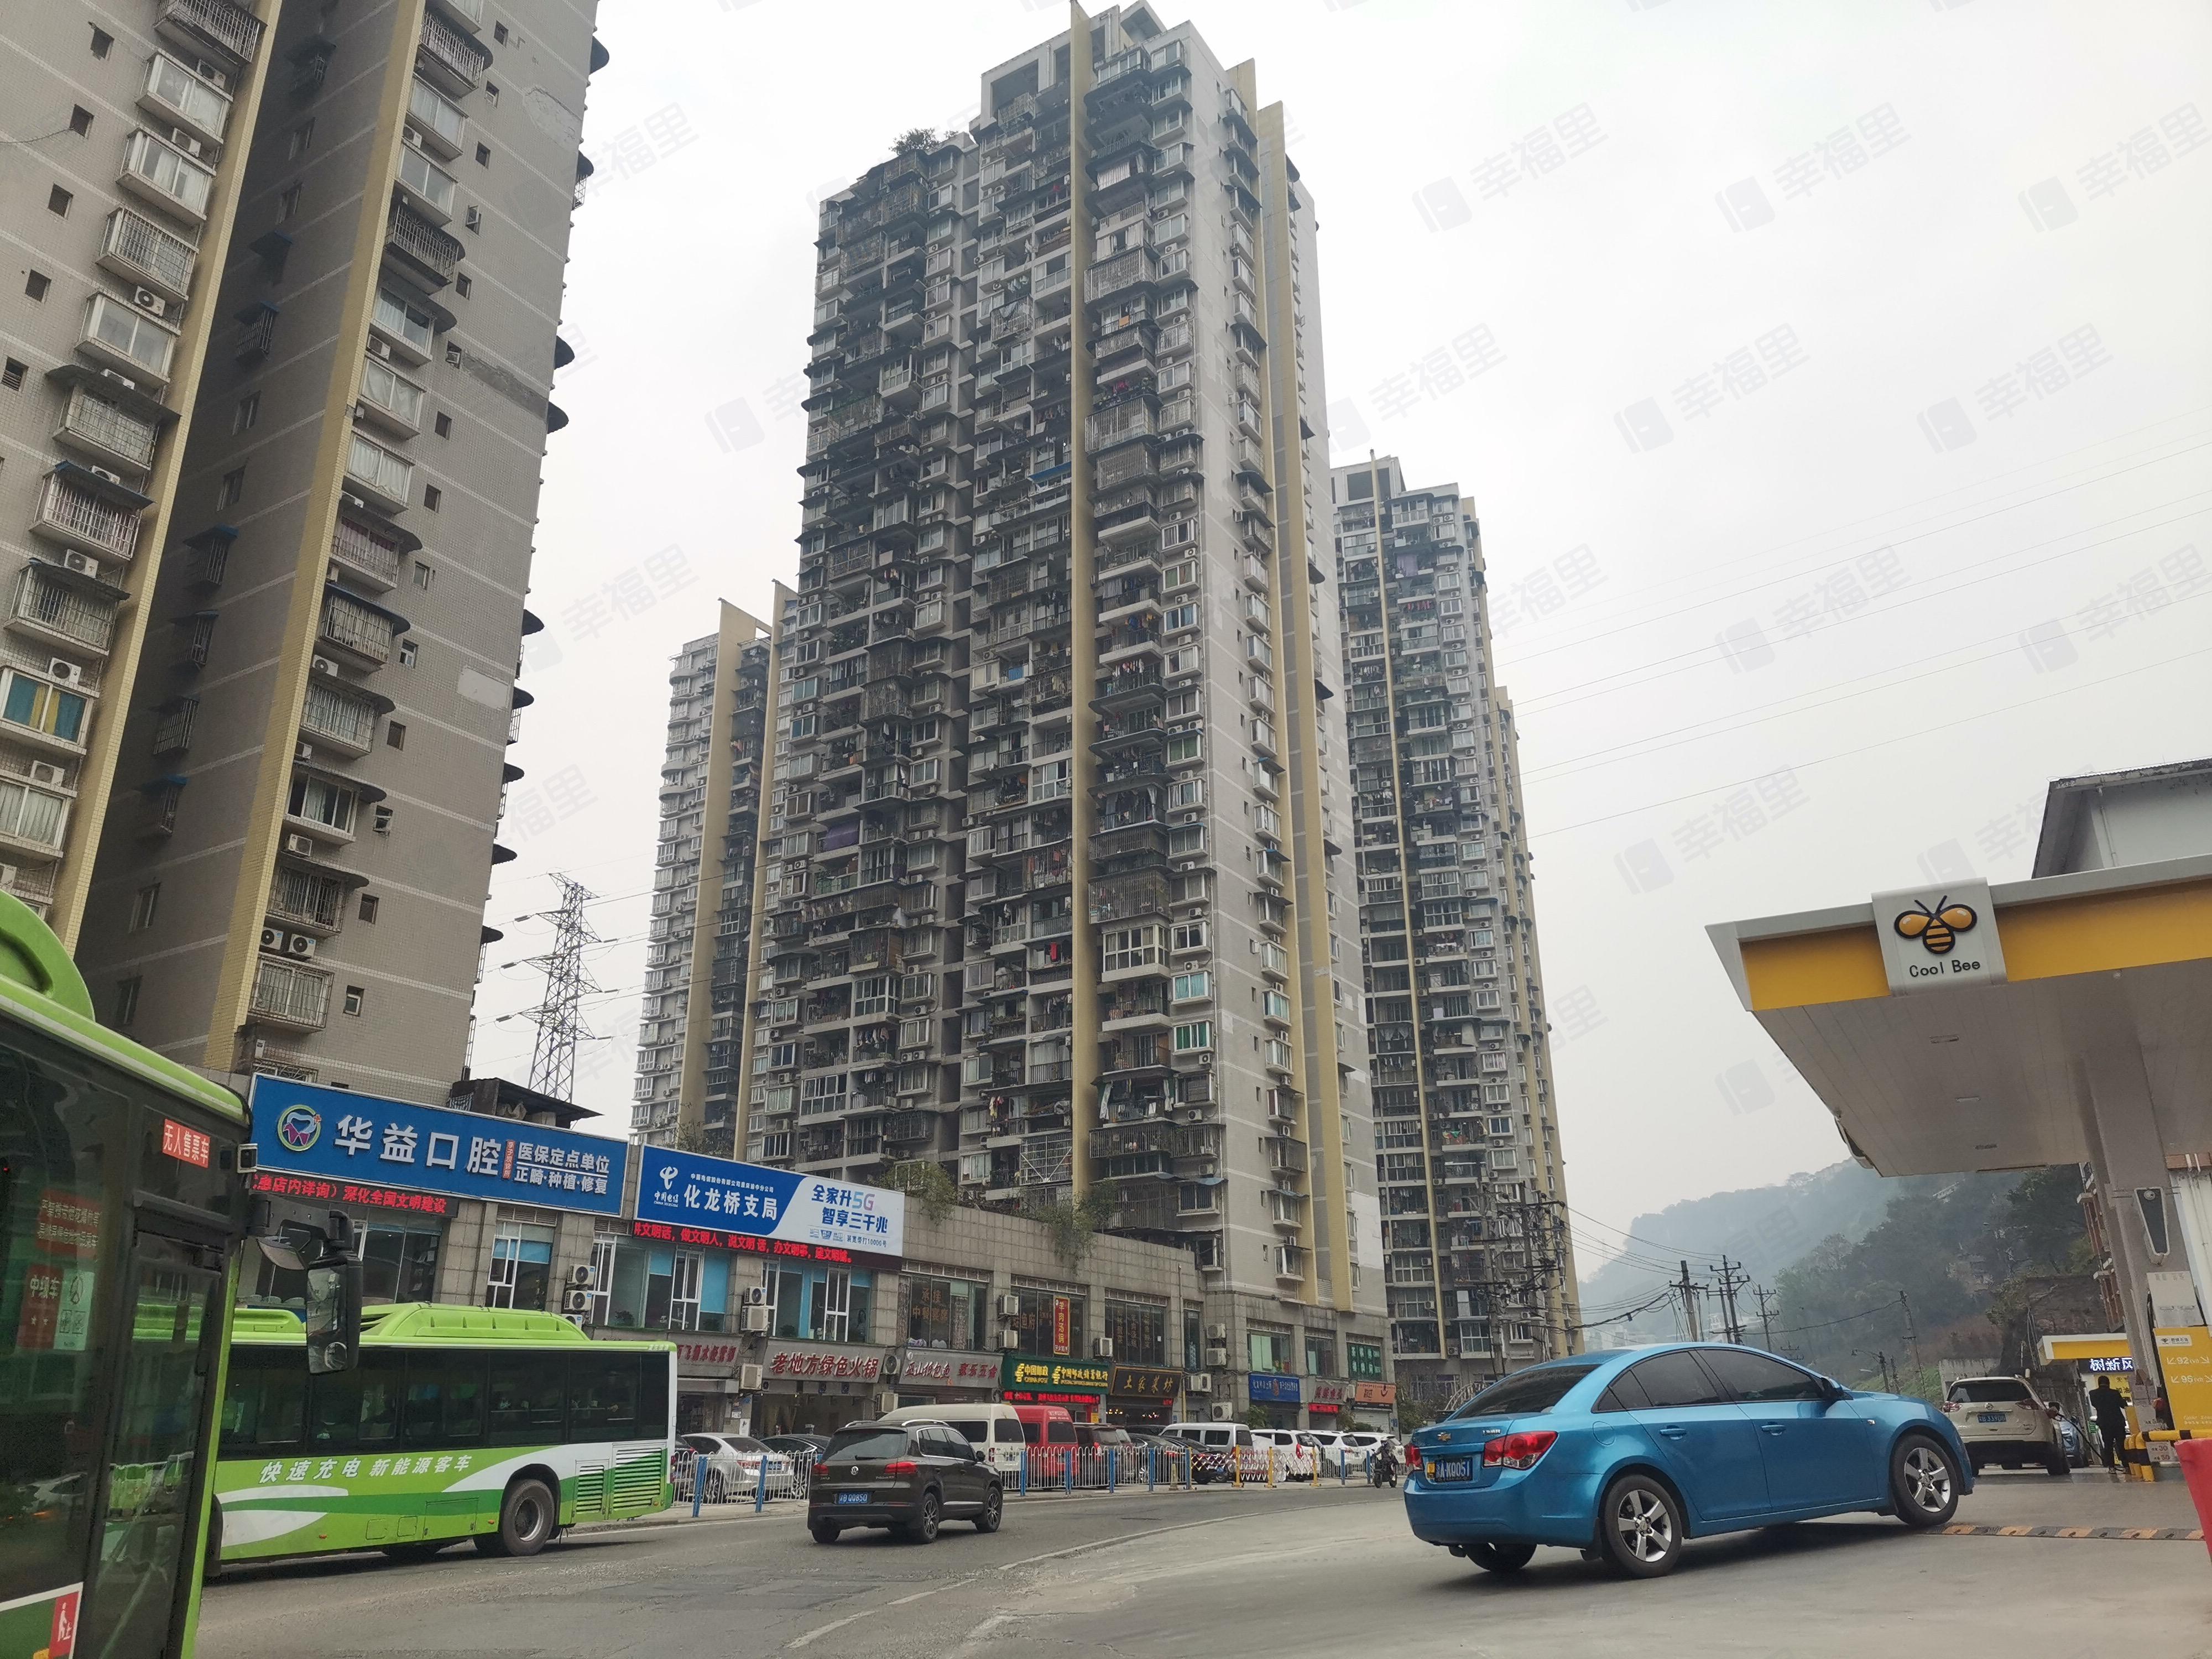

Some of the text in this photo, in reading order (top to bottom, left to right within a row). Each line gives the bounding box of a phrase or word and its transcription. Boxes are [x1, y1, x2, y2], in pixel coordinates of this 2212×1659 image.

[1910, 959, 1980, 977] Cool Bee
[164, 1124, 209, 1164] 无人售票车
[335, 1115, 501, 1175] 华益口腔
[518, 1142, 609, 1173] 医保定点单位
[514, 1166, 607, 1194] 正畸·种植·修复
[343, 1186, 446, 1213] 深化全国文明建设
[654, 1191, 679, 1203] 中国电信
[684, 1184, 777, 1220] 化龙桥支局
[811, 1185, 875, 1211] 全家升5G
[822, 1207, 888, 1234] 智享三千兆
[770, 1352, 879, 1379] 老地方绿色火锅
[905, 1361, 951, 1379] 巫山纸包鱼
[1025, 1364, 1108, 1381] 中国邮政 中国邮政储蓄银行
[1124, 1375, 1173, 1394] 土家菜坊
[259, 1455, 472, 1484] 快速充电 新能源客车
